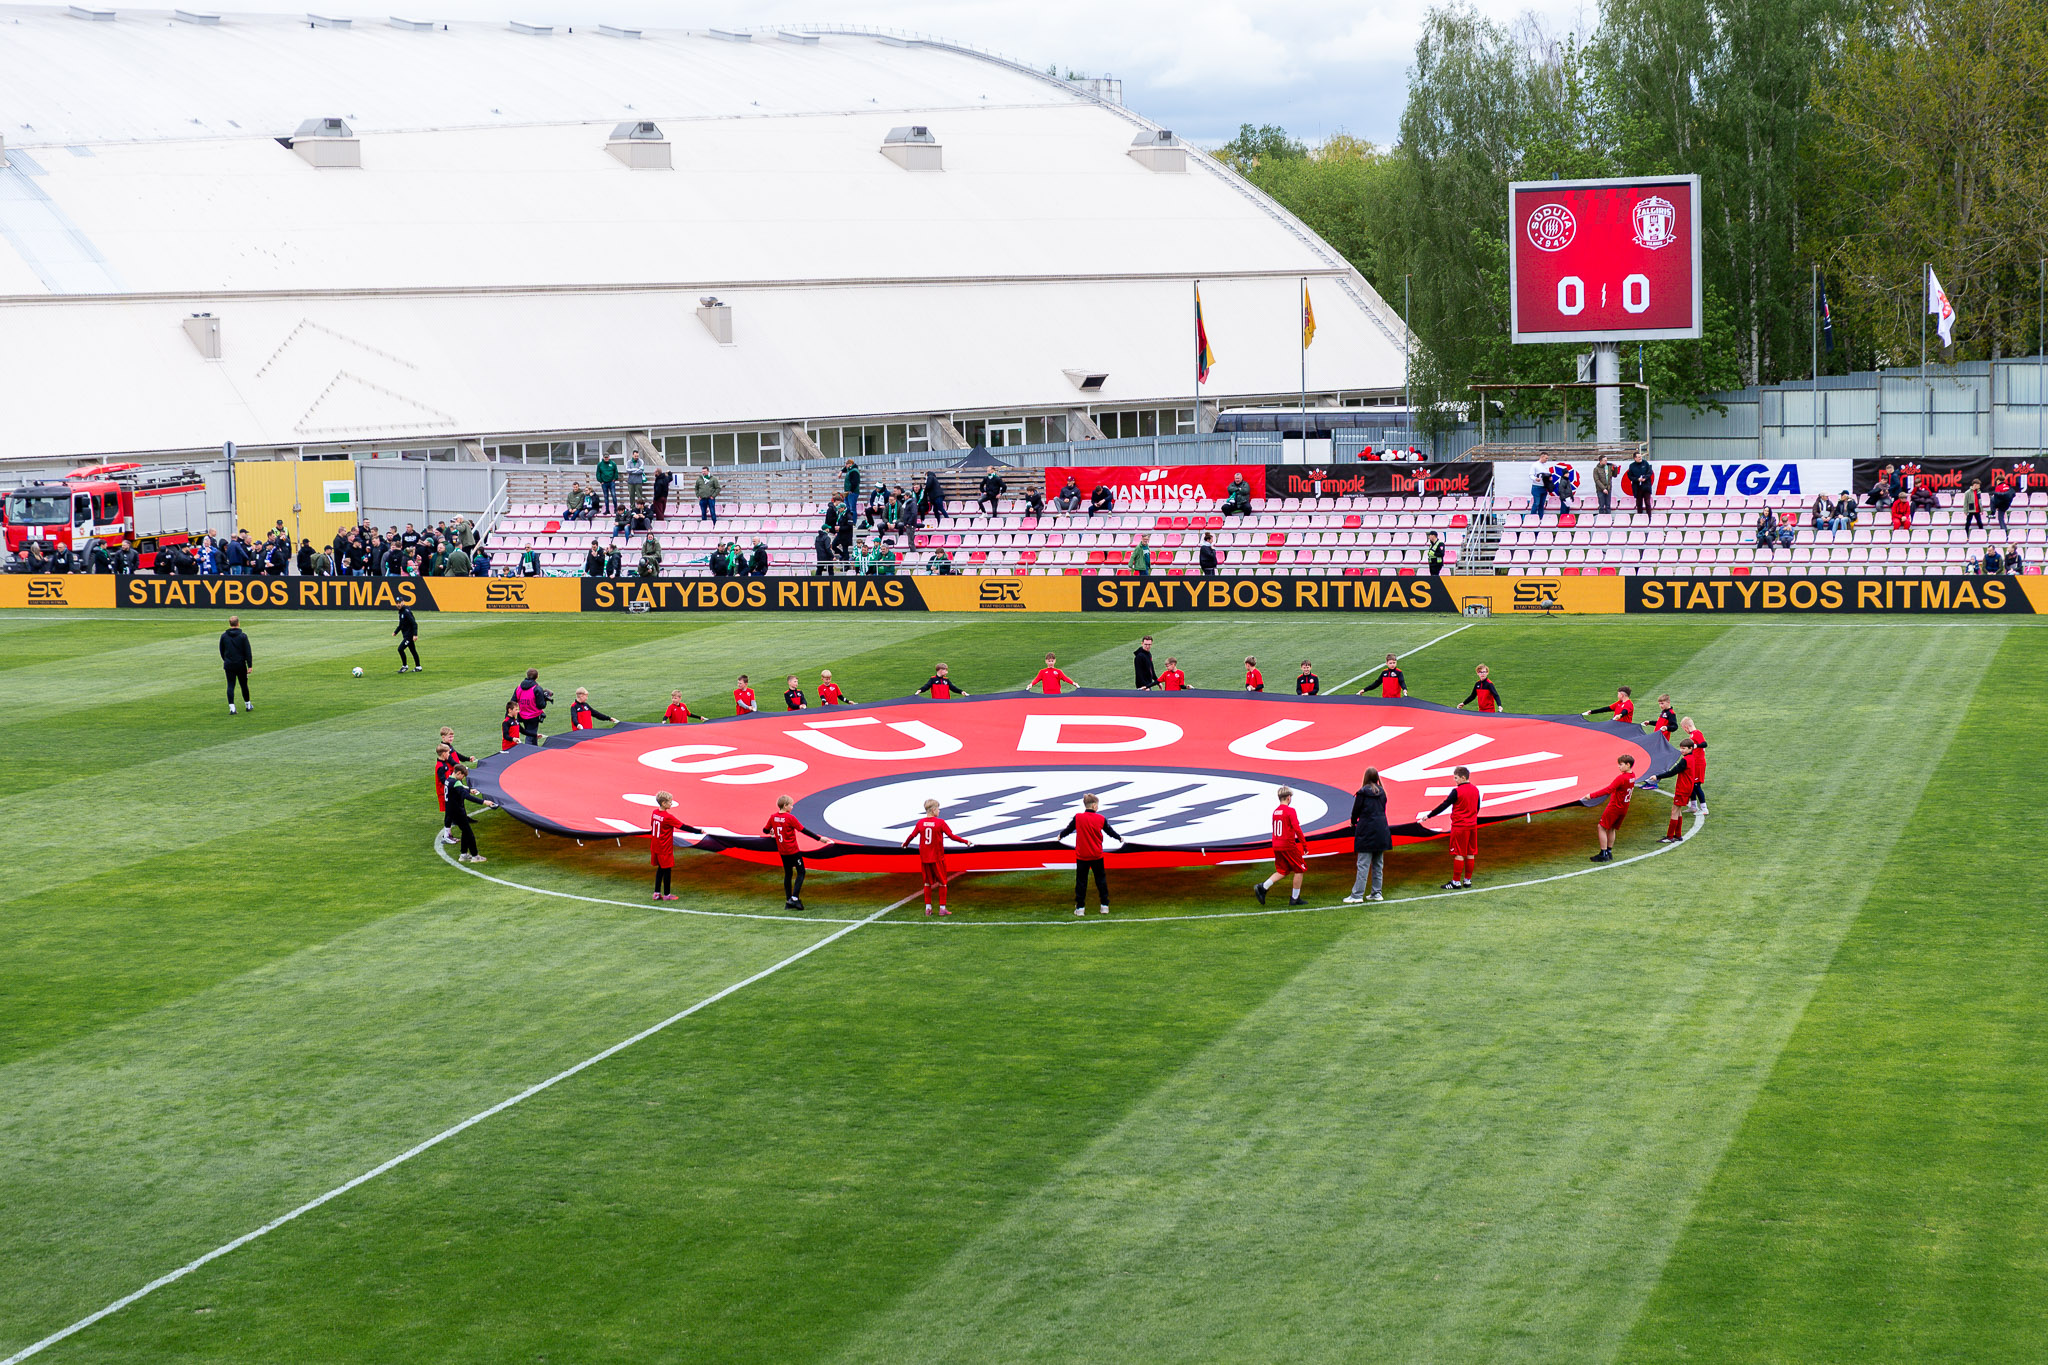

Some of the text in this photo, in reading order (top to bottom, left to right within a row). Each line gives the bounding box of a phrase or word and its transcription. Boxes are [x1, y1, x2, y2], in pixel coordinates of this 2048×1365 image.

[1537, 236, 1567, 247] 1942
[1103, 483, 1207, 499] MANTINGA
[129, 579, 417, 607] STATYBOS RITMAS
[595, 580, 905, 608] STATYBOS RITMAS
[1096, 580, 1432, 608] STATYBOS RITMAS
[1641, 580, 2007, 609] STATYBOS RITMAS
[652, 819, 660, 838] 17
[776, 826, 783, 843] 5
[924, 827, 932, 845] 9
[1273, 819, 1283, 837] 10
